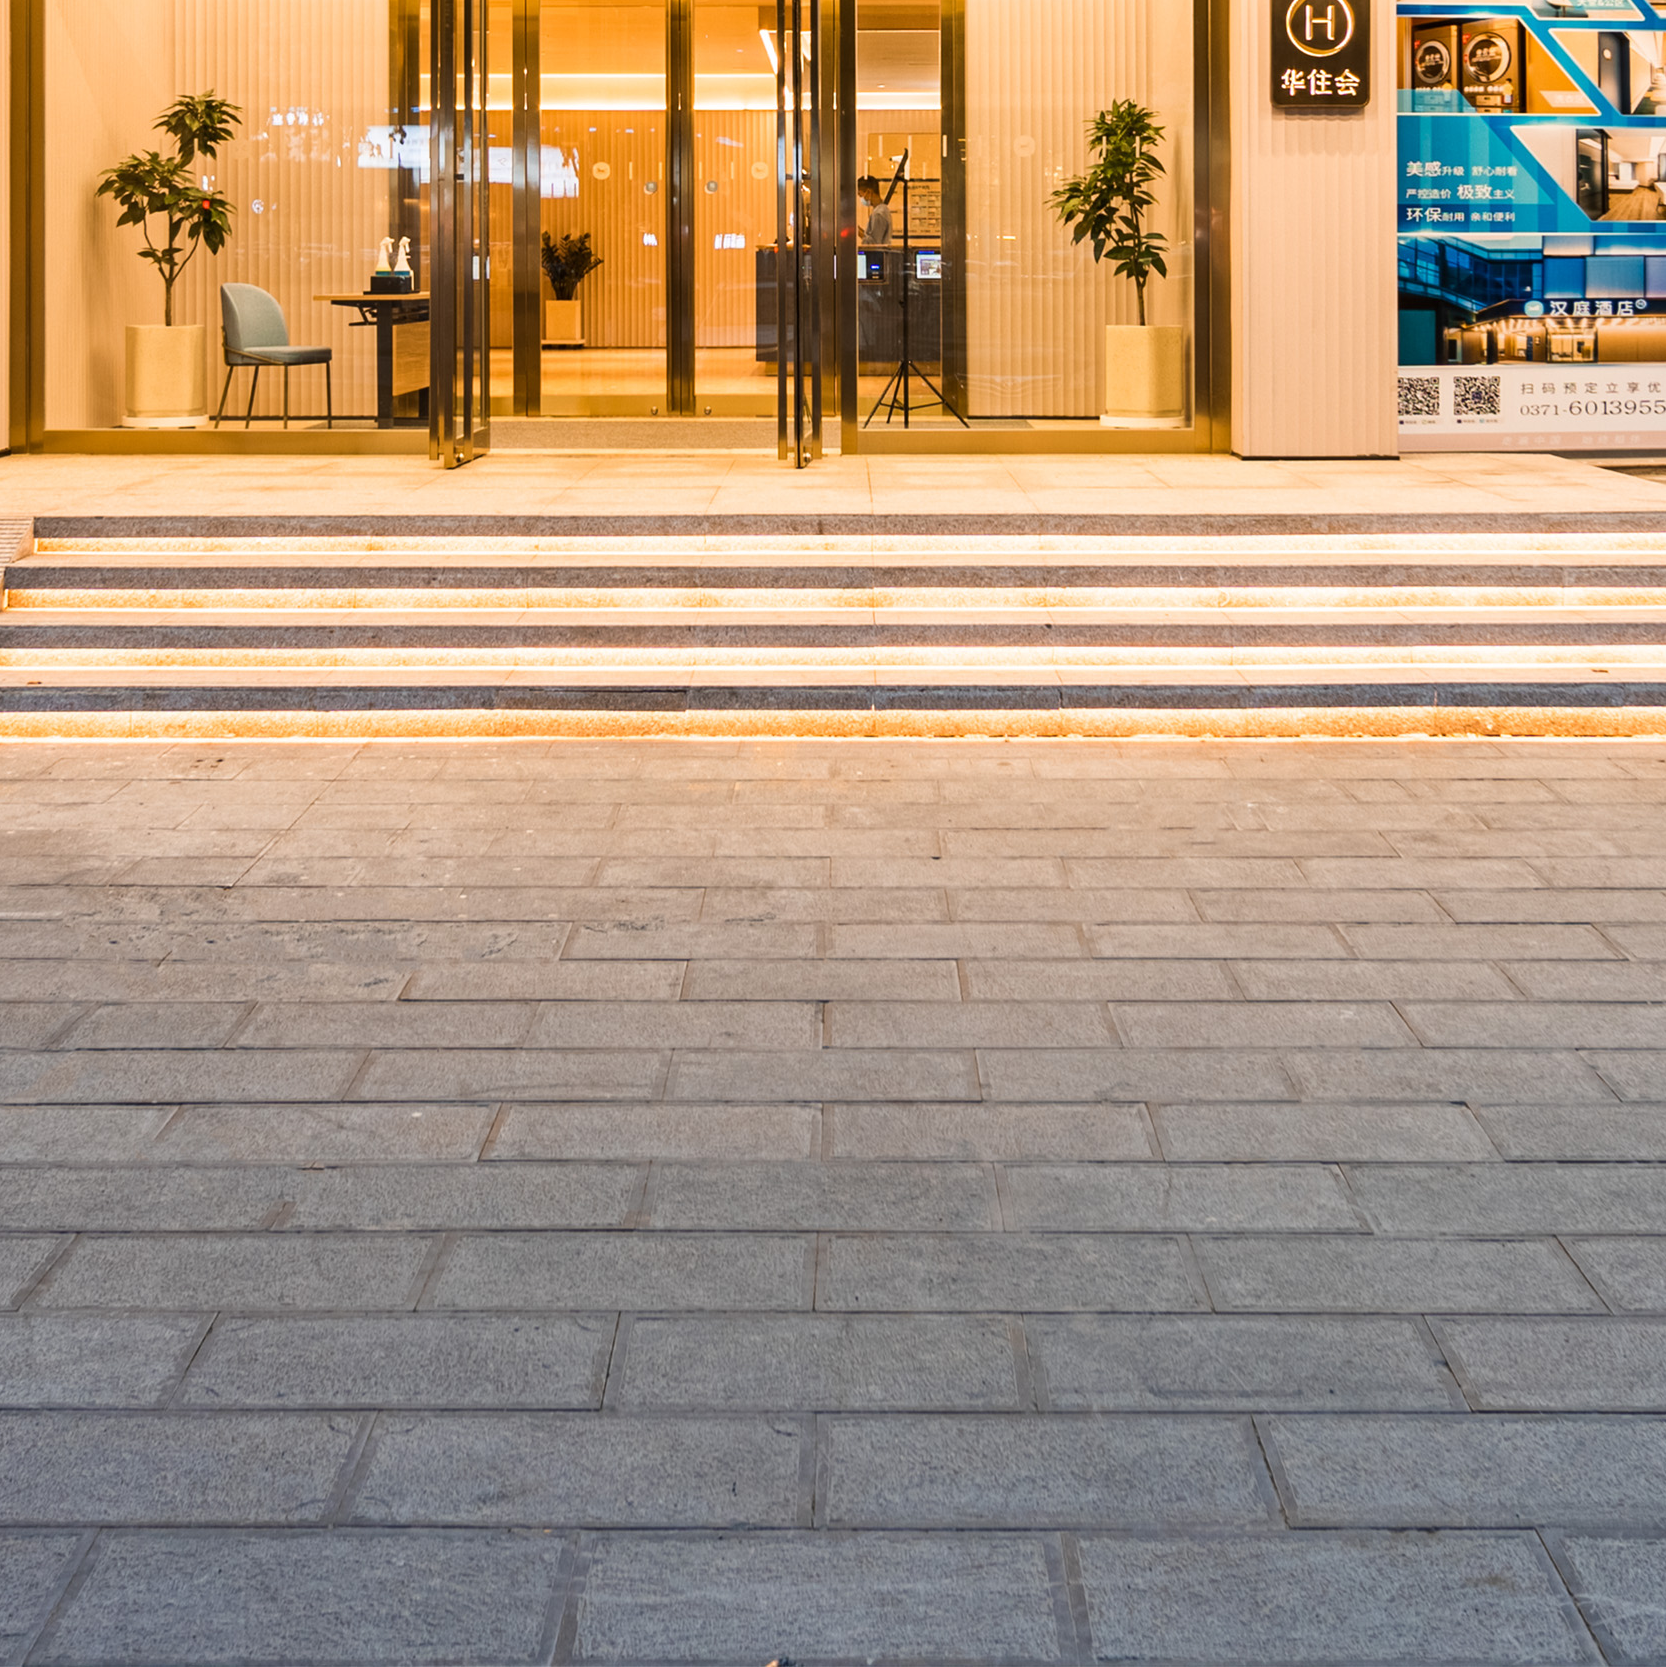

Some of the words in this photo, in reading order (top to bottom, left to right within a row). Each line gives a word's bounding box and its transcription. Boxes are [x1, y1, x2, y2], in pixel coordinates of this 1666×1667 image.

[1281, 68, 1360, 96] 华住会
[1406, 161, 1465, 177] 美感升级
[1457, 184, 1515, 200] 极致主义
[1406, 207, 1465, 222] 环保耐用
[1471, 212, 1516, 222] 亲和便利
[1550, 300, 1634, 317] 汉庭酒店
